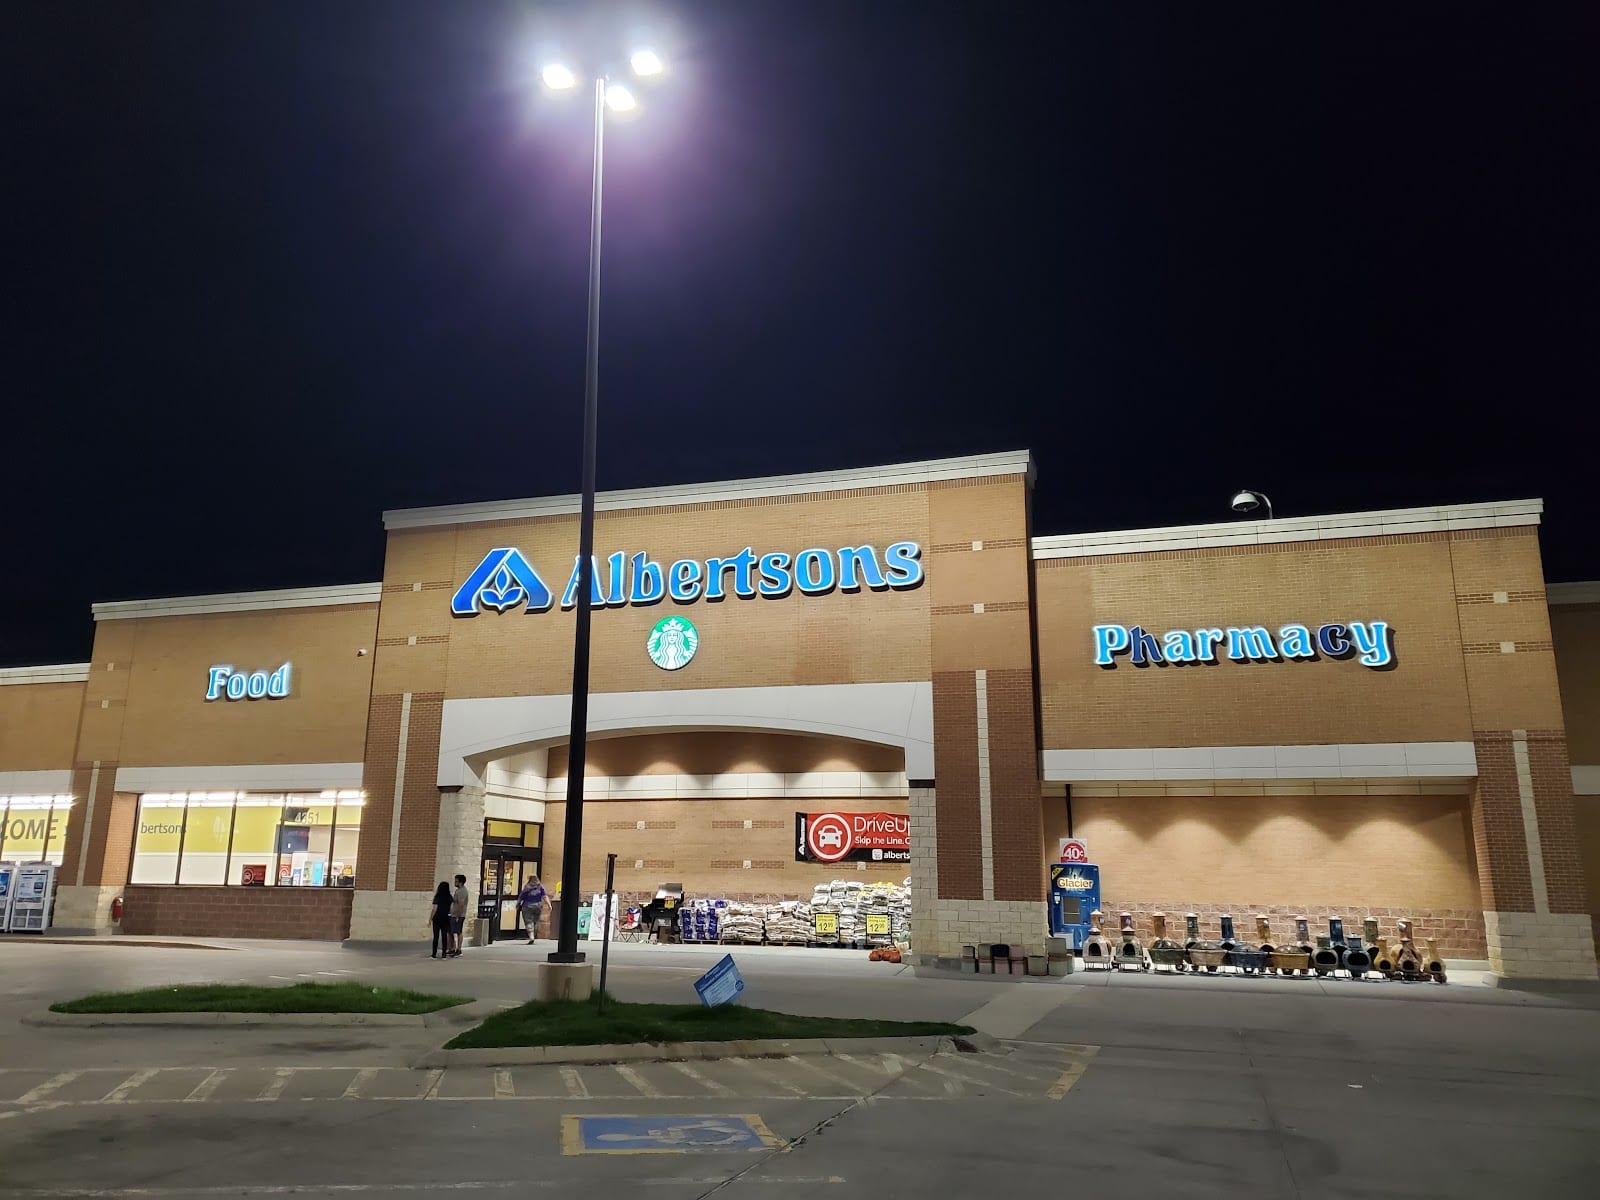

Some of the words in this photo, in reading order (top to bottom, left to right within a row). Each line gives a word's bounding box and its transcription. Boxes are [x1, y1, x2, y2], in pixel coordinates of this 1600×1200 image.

[560, 542, 925, 608] Albertsons
[1093, 621, 1393, 668] Pharmacy
[205, 662, 292, 700] Food
[3, 818, 59, 840] OME
[141, 822, 186, 834] bertson
[855, 835, 871, 846] Skip
[872, 836, 885, 845] the
[1058, 877, 1093, 888] Glacier
